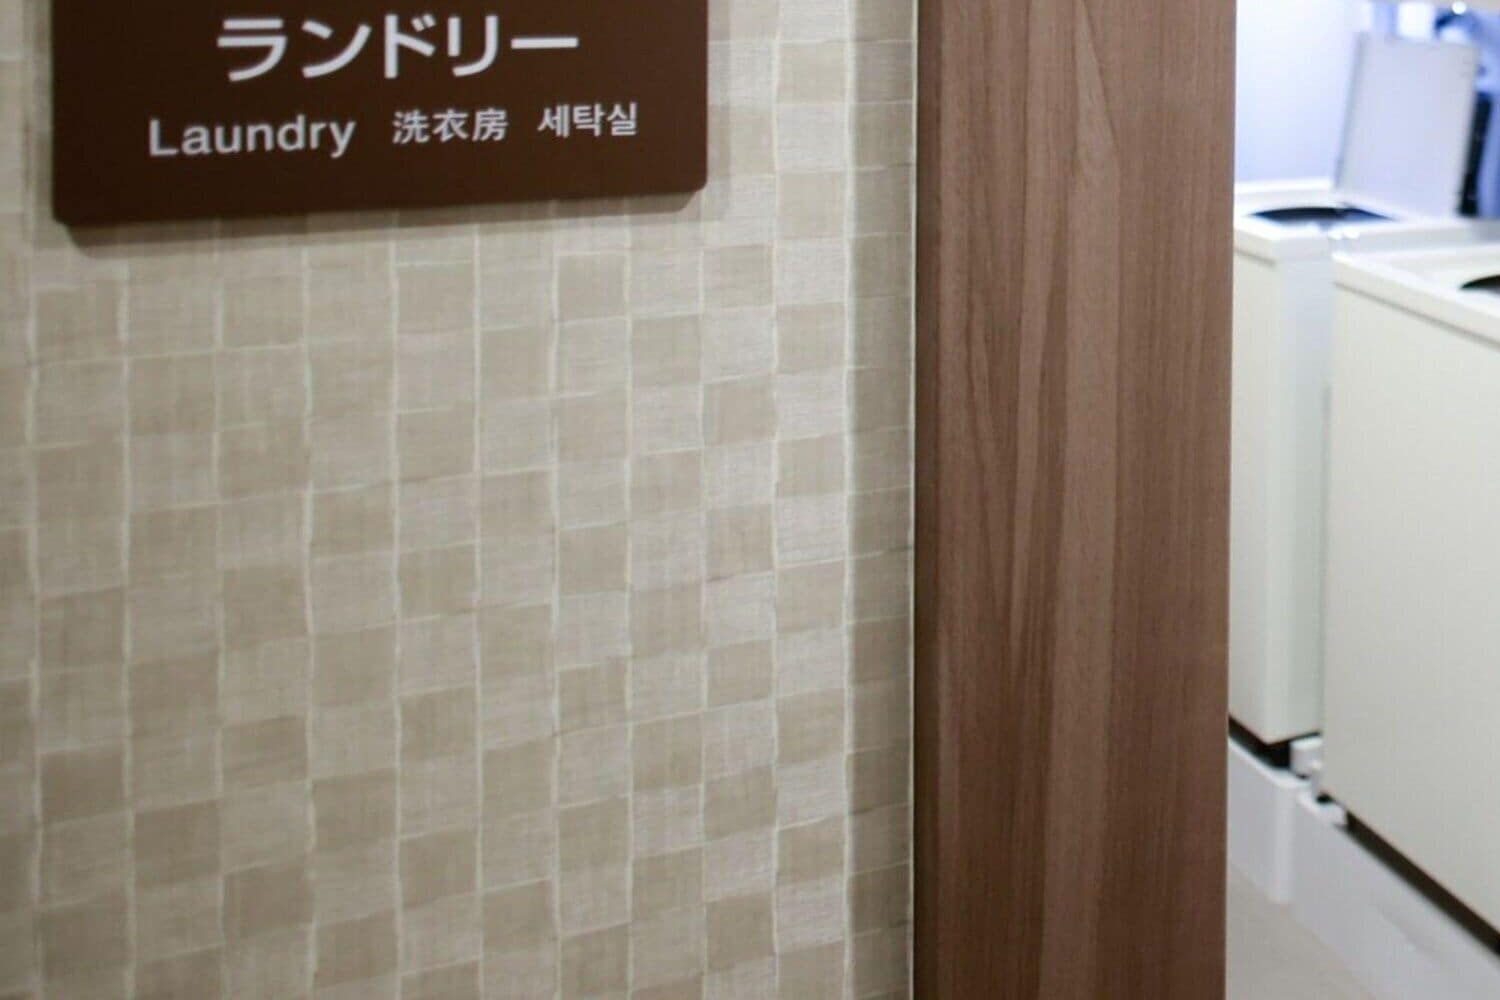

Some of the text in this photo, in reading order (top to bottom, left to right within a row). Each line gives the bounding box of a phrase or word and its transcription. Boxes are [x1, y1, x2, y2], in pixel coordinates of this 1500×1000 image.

[216, 13, 579, 82] ランドリー
[149, 101, 638, 159] Laundry 洗衣房 세탁실
